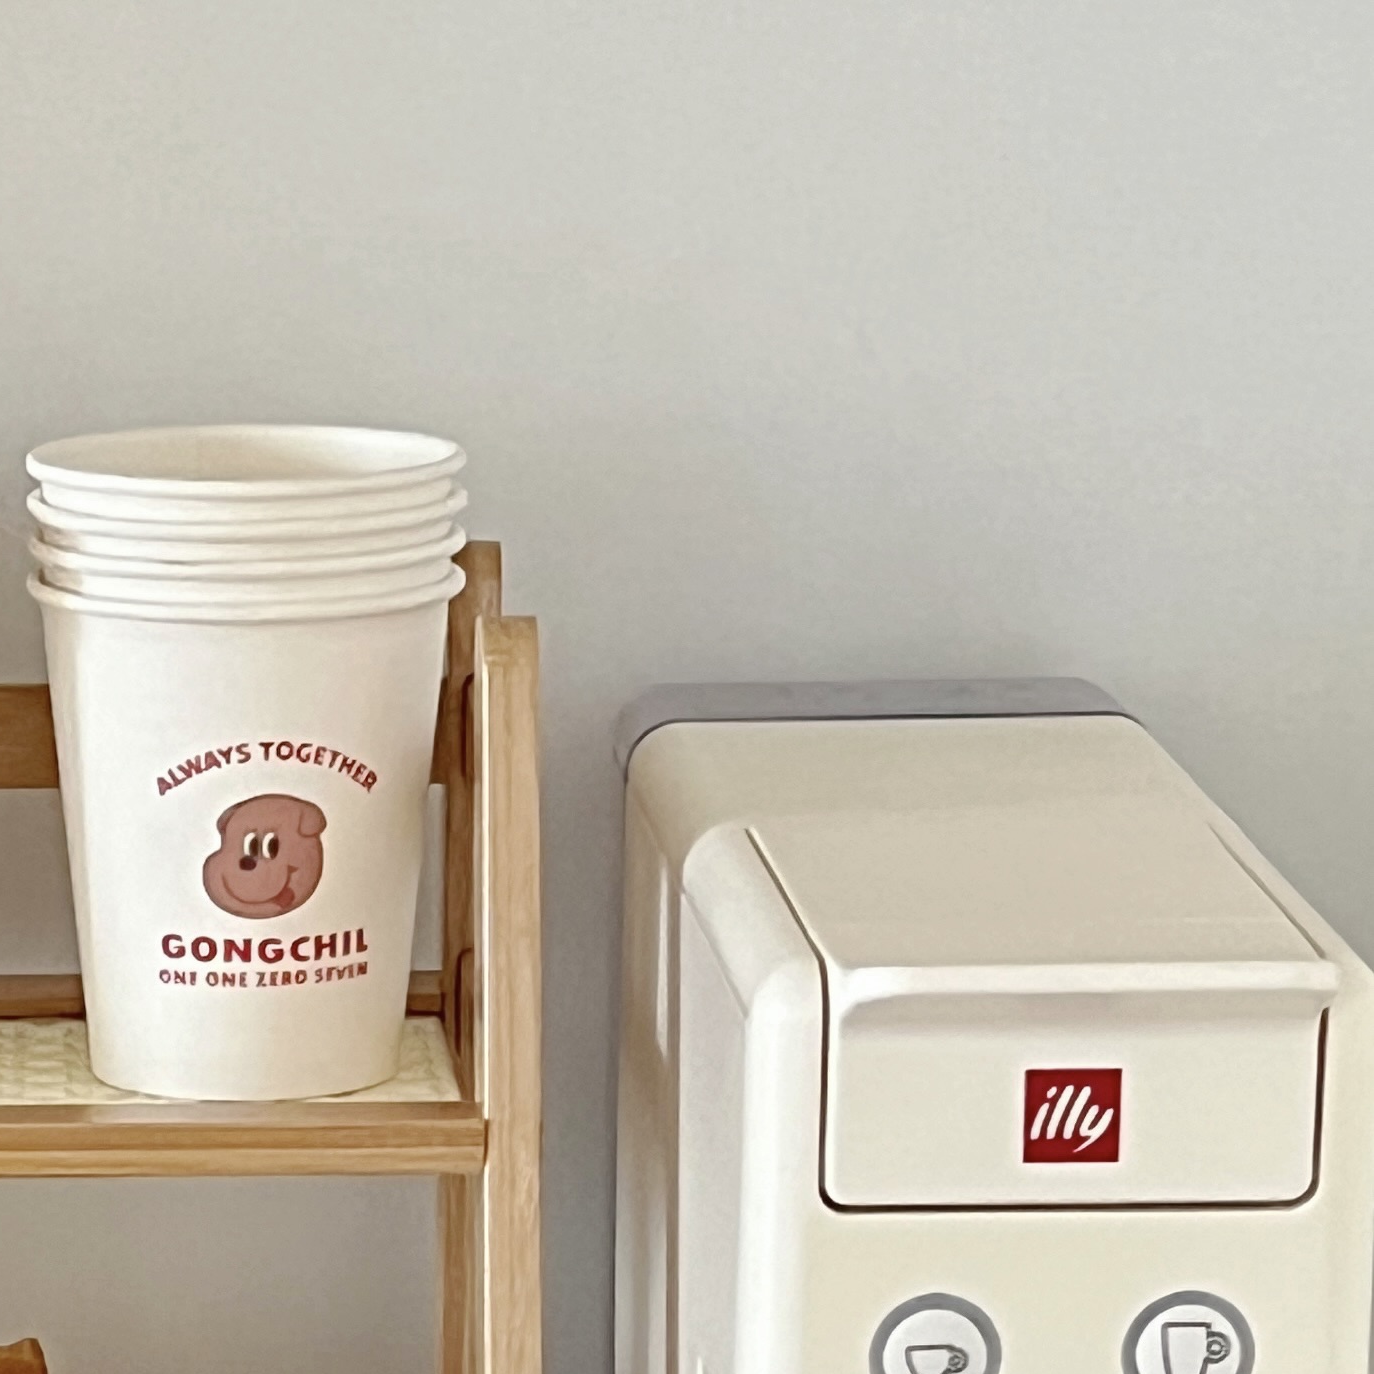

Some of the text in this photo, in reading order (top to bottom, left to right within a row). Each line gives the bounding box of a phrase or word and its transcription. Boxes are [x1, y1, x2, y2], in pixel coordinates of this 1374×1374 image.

[156, 741, 379, 796] ALWAYS TOGETHER
[161, 928, 369, 965] GONGCHIL
[205, 971, 247, 988] ONE
[255, 969, 307, 988] ZERO
[1029, 1084, 1115, 1154] illy
